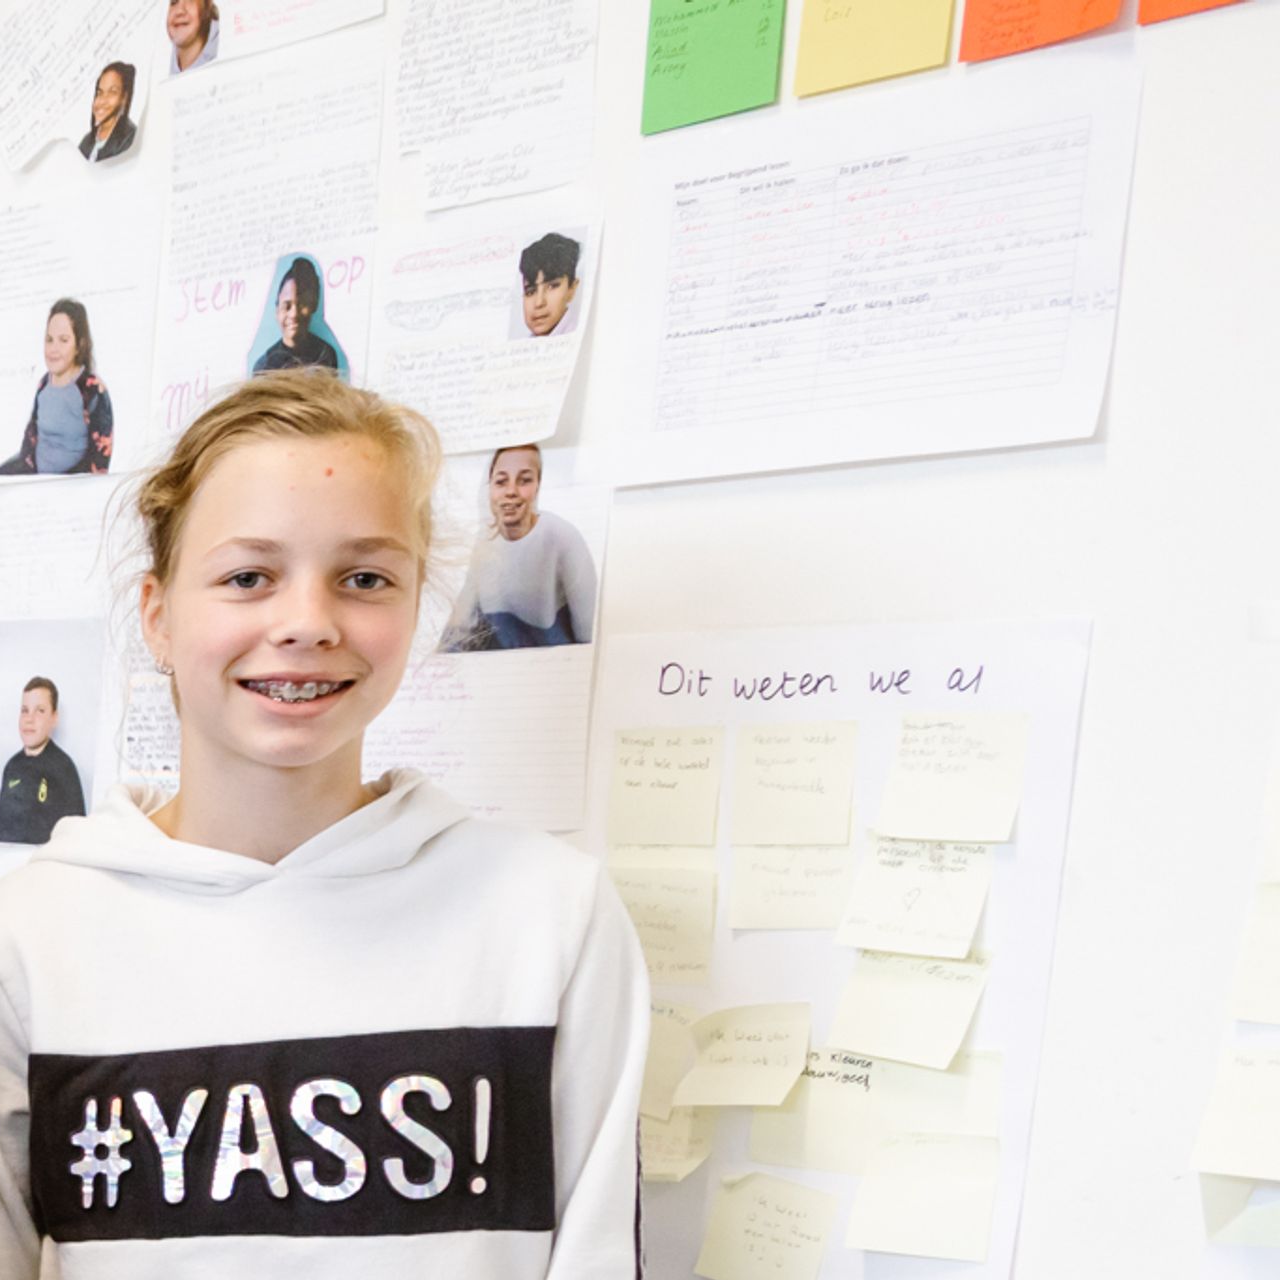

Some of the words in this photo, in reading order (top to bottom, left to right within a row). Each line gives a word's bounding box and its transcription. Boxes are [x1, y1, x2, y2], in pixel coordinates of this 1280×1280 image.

[658, 662, 713, 697] Dit
[733, 670, 839, 700] weten
[869, 668, 912, 695] we
[946, 665, 985, 694] al
[69, 1075, 491, 1209] #YASS!
